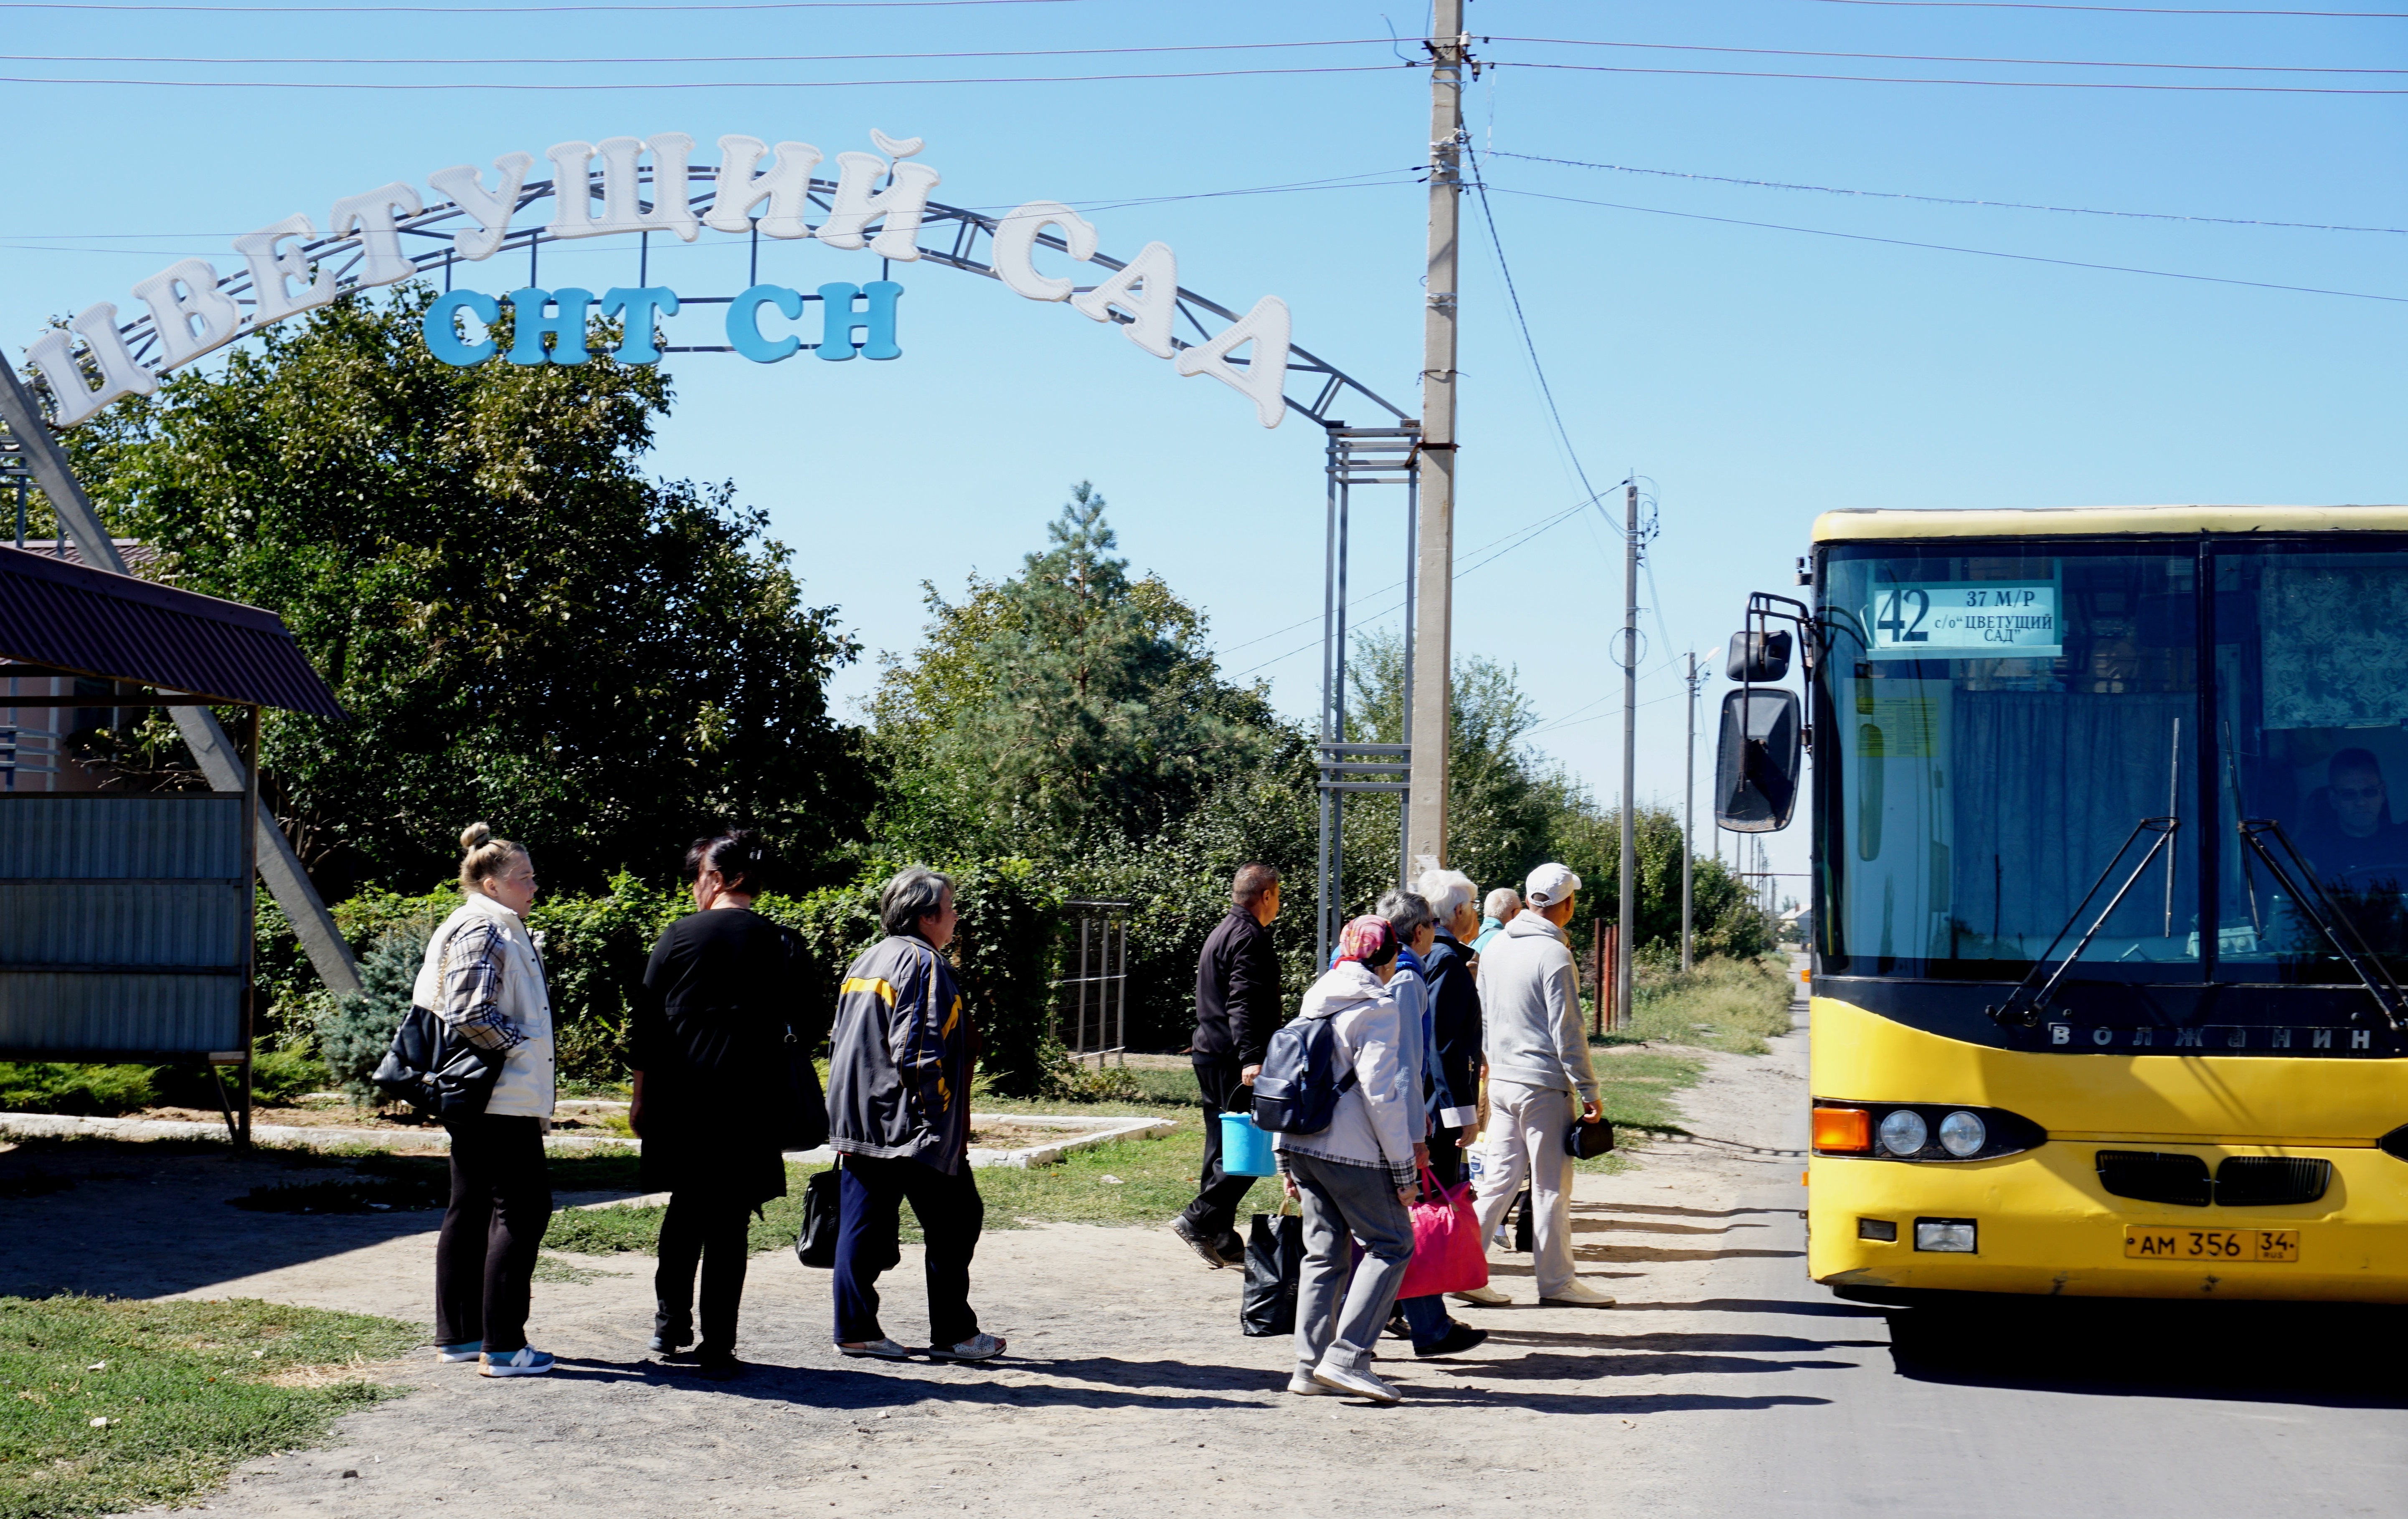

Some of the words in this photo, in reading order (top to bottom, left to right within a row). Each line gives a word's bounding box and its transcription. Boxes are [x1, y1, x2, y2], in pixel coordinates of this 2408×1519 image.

[26, 127, 941, 428] ЦВЕТУЩИЙ
[992, 200, 1292, 429] САД
[423, 287, 679, 368] СНТ
[726, 281, 904, 364] СН
[1878, 589, 1930, 642] 42
[1966, 591, 1987, 607] 37
[1995, 589, 2035, 608] М/Р
[2188, 1232, 2241, 1257] 356
[2260, 1232, 2288, 1251] 34
